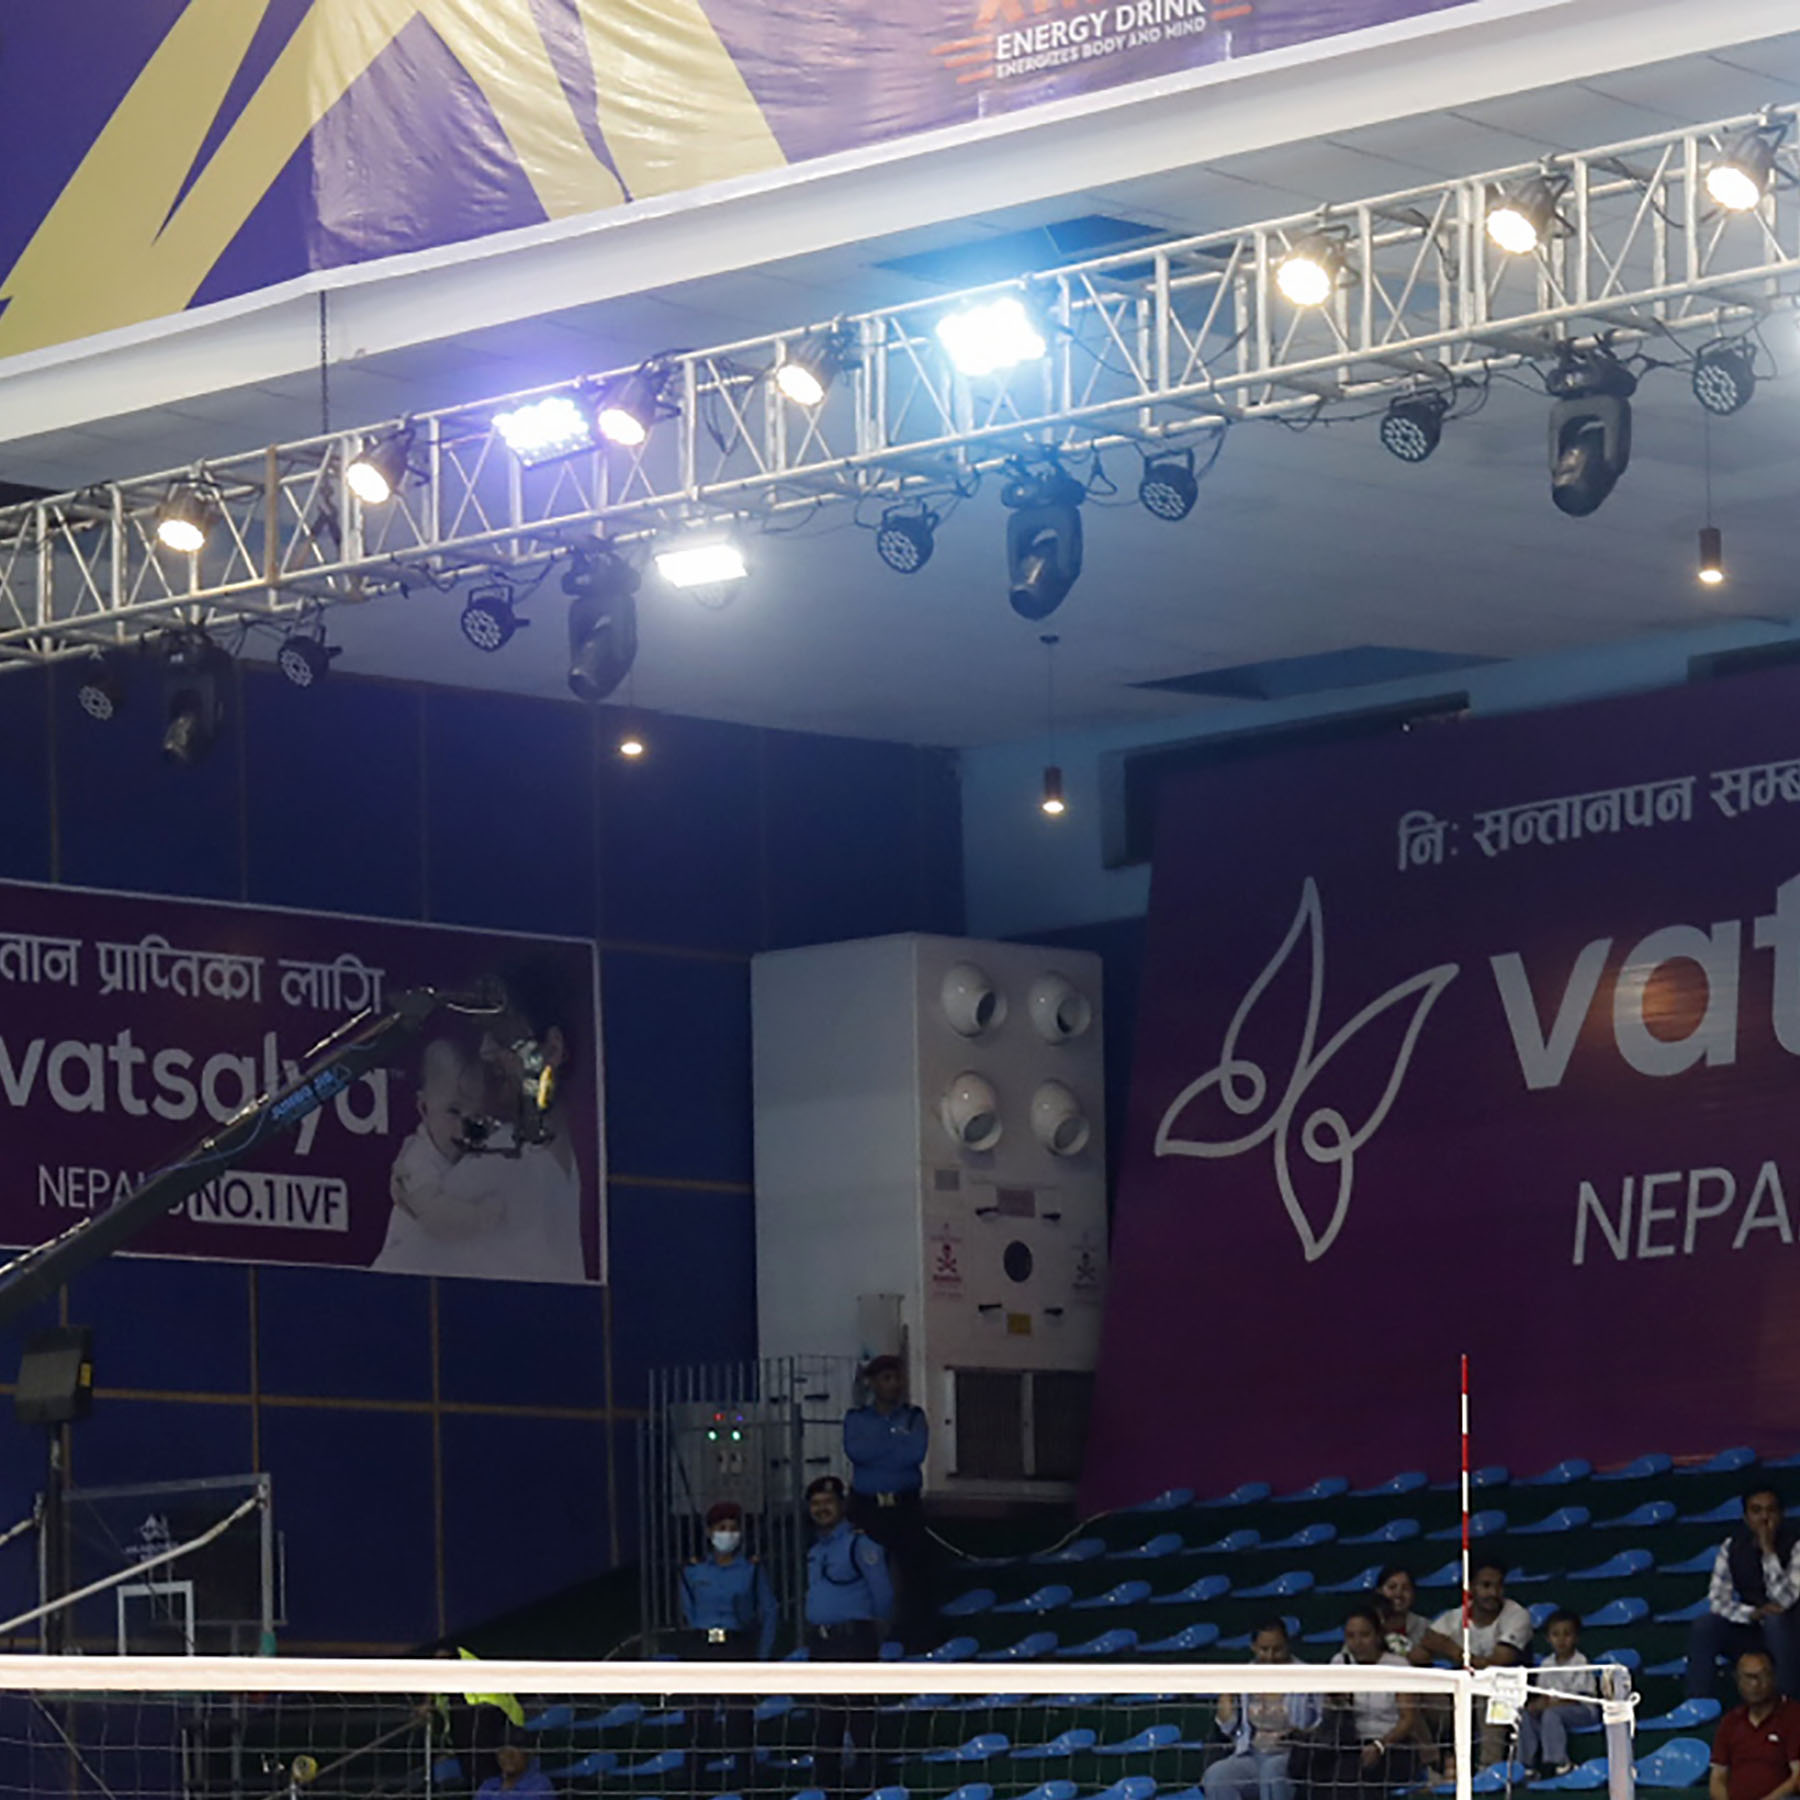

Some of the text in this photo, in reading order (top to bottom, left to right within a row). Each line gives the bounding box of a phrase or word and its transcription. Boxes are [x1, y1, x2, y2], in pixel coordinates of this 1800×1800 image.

[997, 9, 1108, 60] ENERGY
[1116, 0, 1206, 31] DRINK
[1082, 36, 1125, 58] BODY
[1127, 28, 1161, 48] AND
[1165, 16, 1206, 39] MIND
[97, 934, 264, 1002] प्राप्तिका
[279, 953, 386, 1013] लागि
